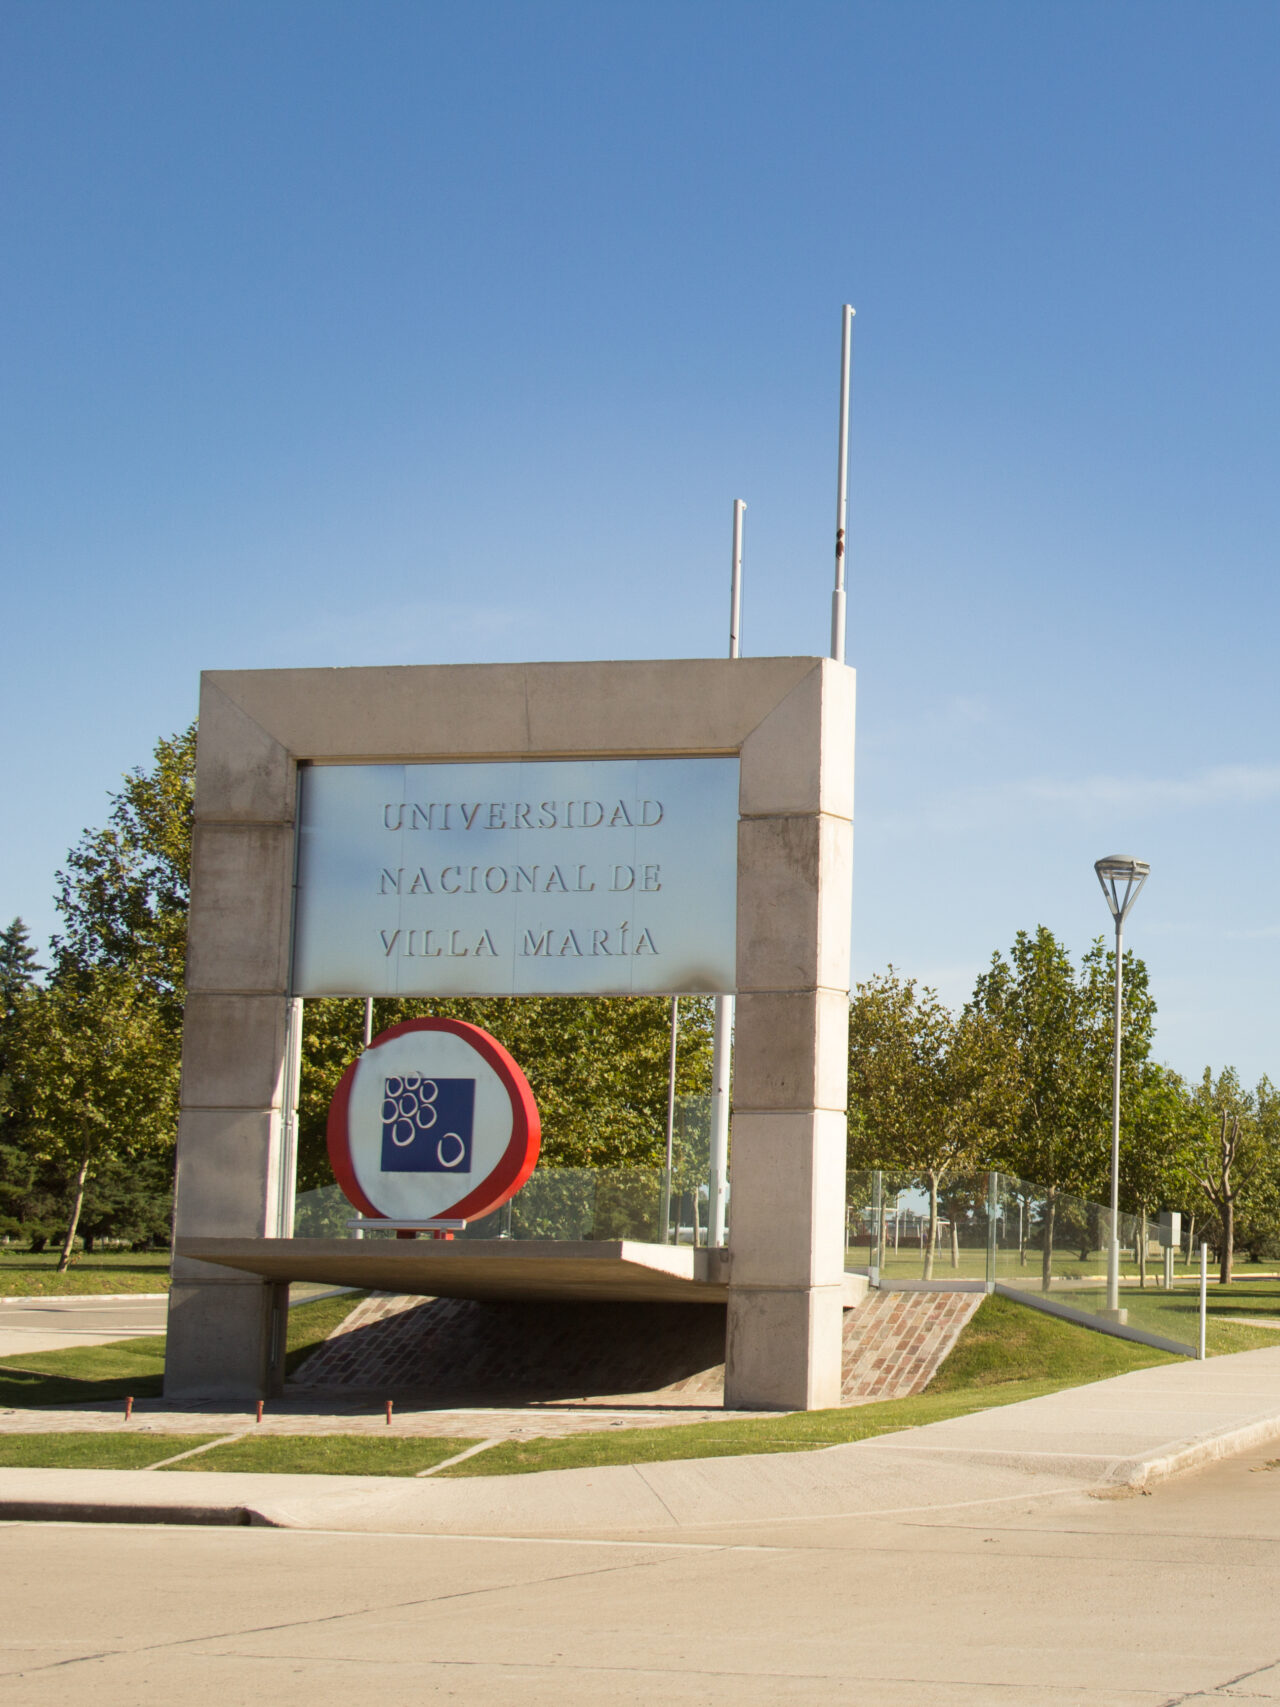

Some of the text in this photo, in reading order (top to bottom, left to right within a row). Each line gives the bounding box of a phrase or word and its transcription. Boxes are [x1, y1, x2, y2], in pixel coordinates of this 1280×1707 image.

[382, 799, 665, 831] UNIVERSIDAD
[376, 863, 662, 895] NACIONAL DE
[376, 921, 661, 957] VILLA MARÍA
